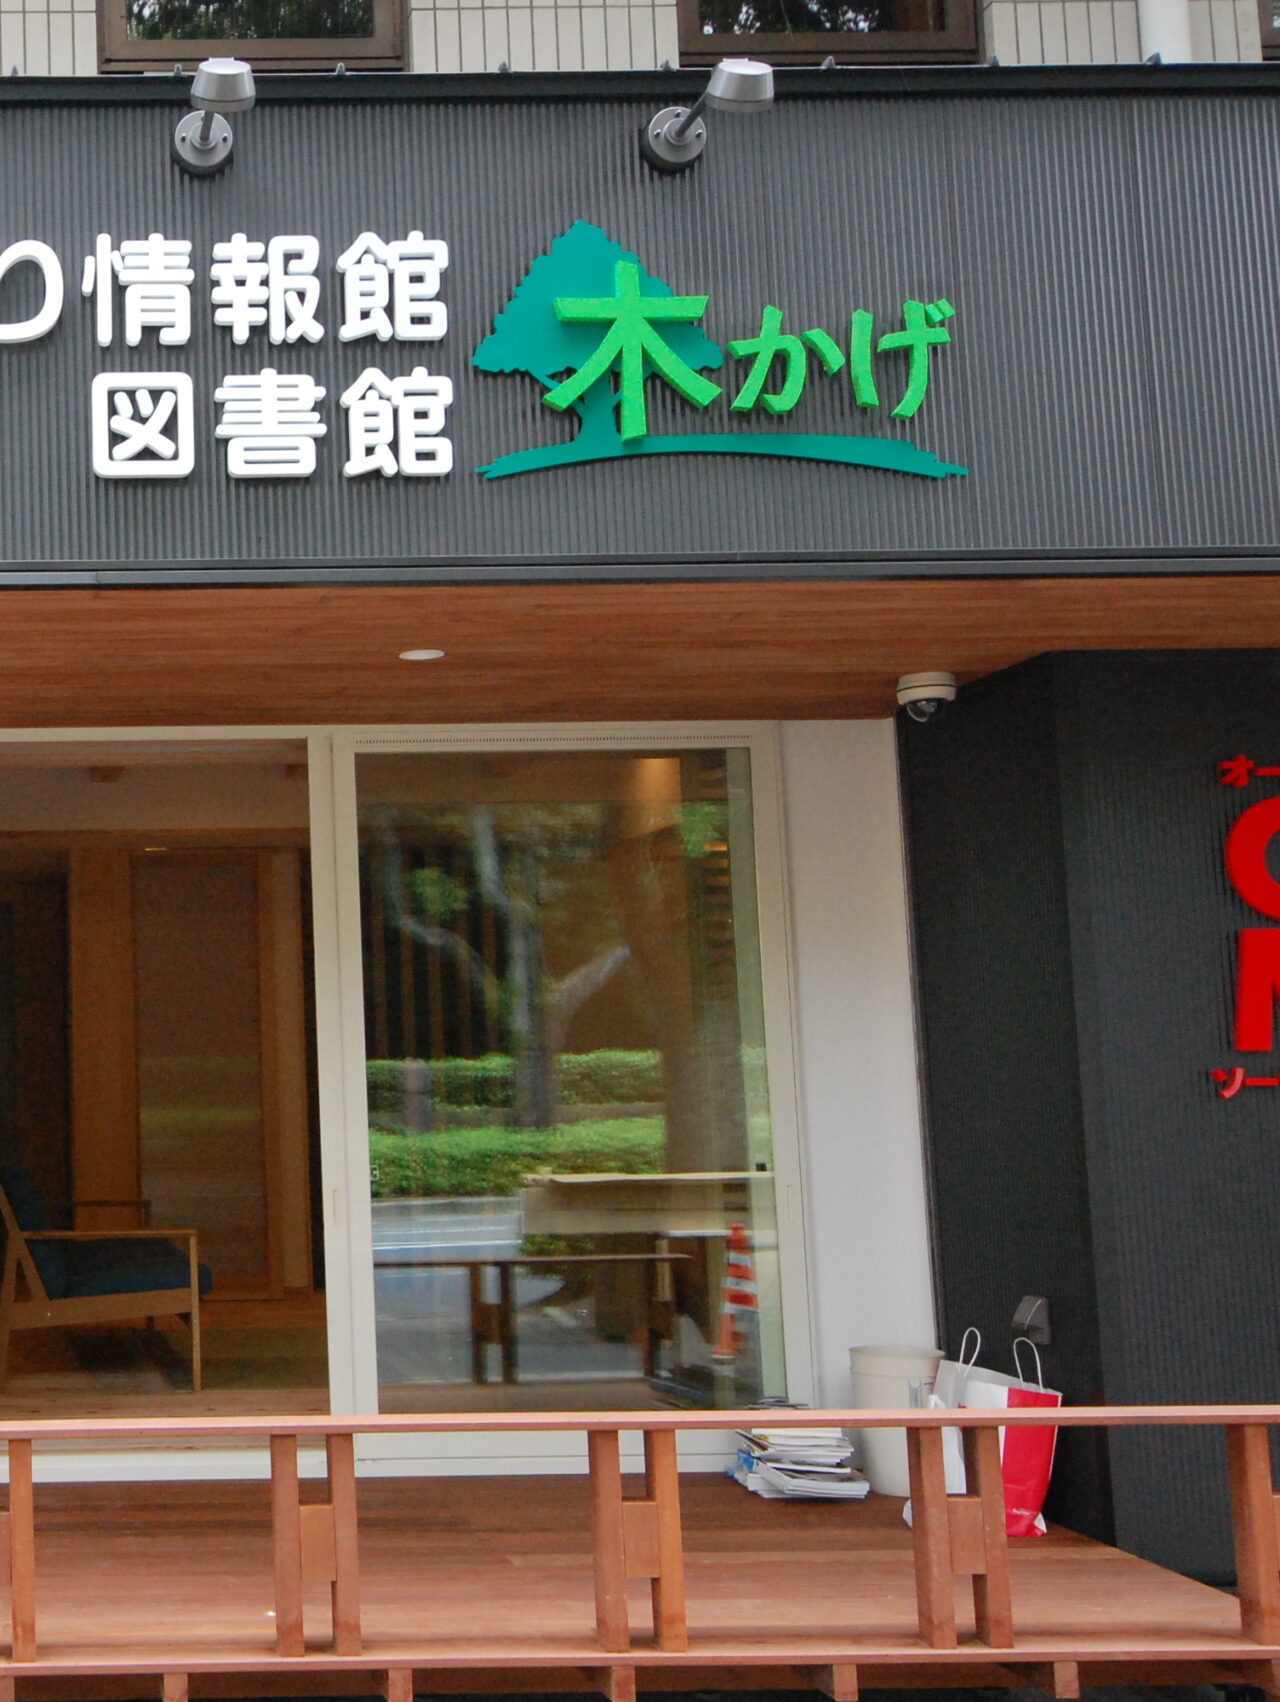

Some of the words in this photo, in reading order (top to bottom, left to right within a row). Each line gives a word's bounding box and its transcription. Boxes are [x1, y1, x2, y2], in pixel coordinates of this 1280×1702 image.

[91, 366, 455, 478] 図書館
[543, 260, 954, 441] 木かげ
